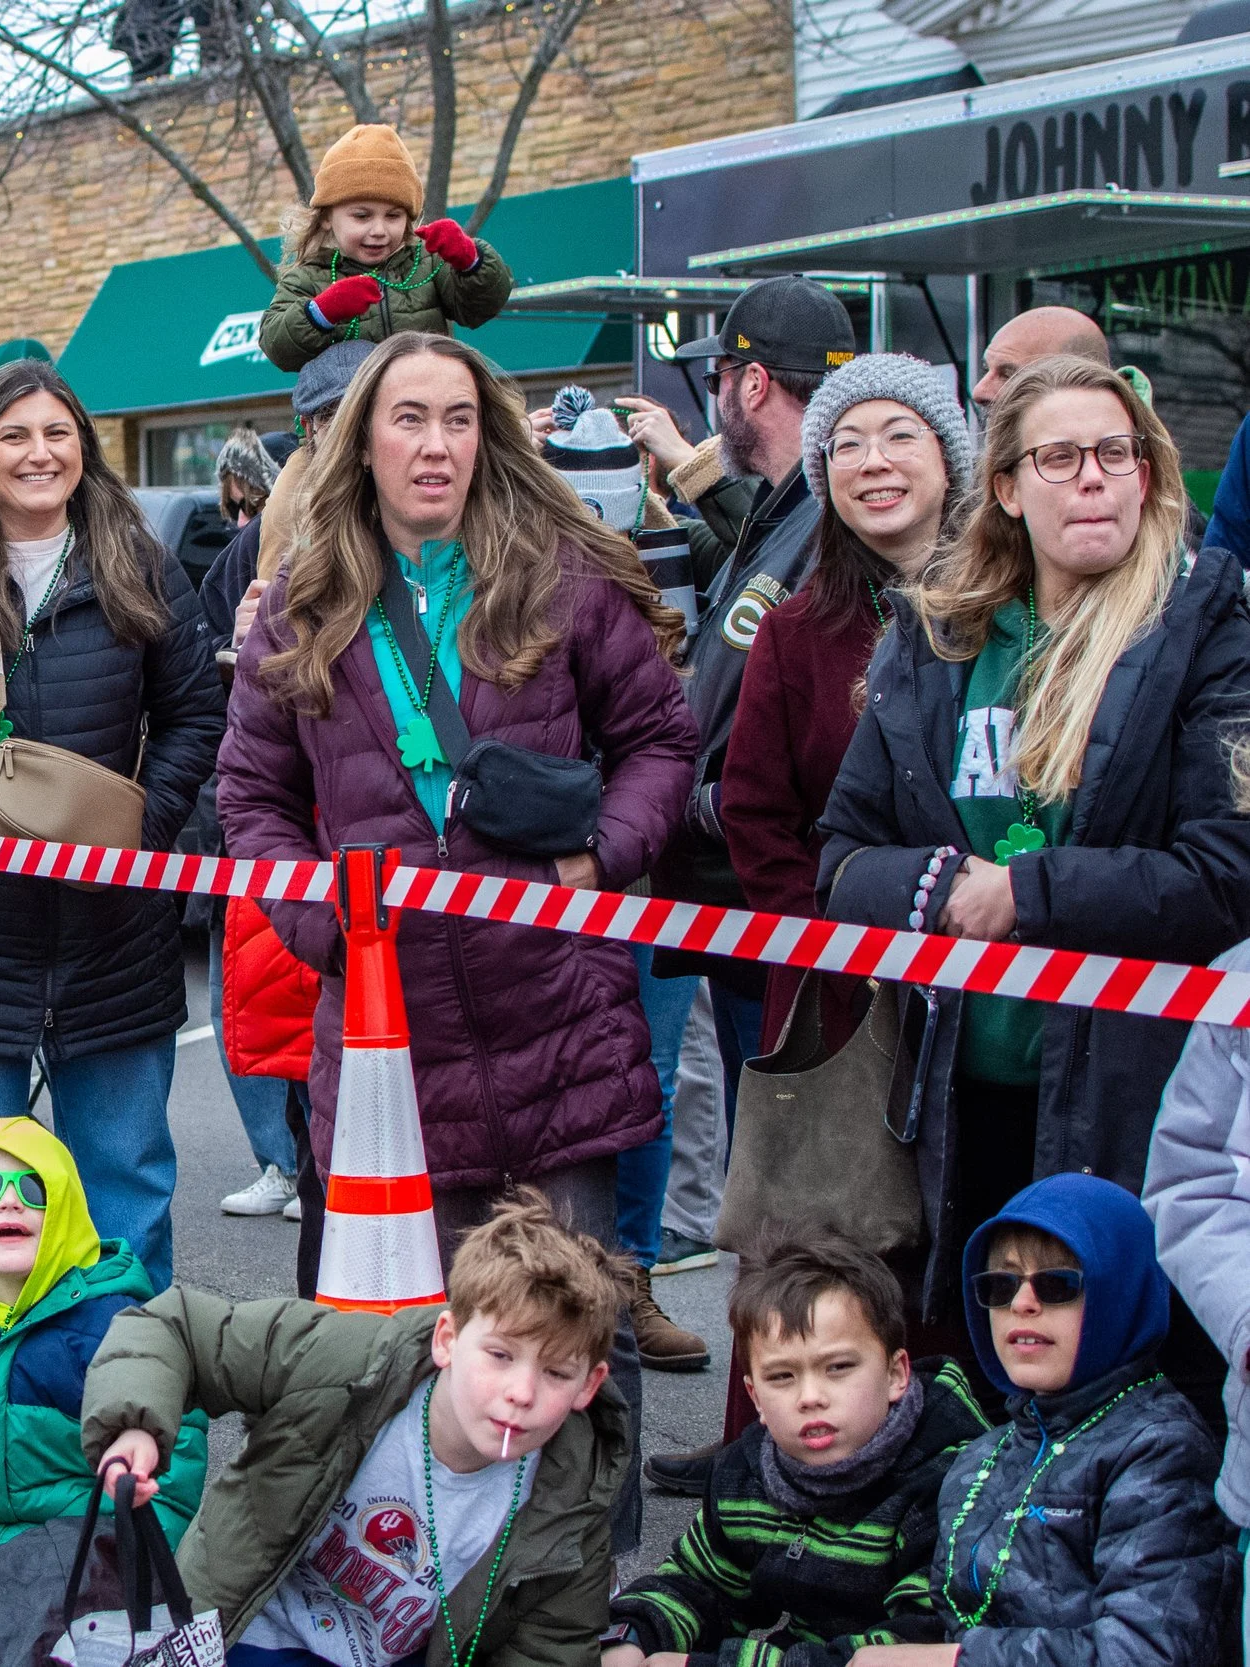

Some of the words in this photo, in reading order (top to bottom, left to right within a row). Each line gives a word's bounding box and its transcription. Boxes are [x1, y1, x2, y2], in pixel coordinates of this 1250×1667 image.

[970, 87, 1207, 207] JOHNNY
[333, 1496, 358, 1521] 20
[311, 1523, 407, 1624] BOWL
